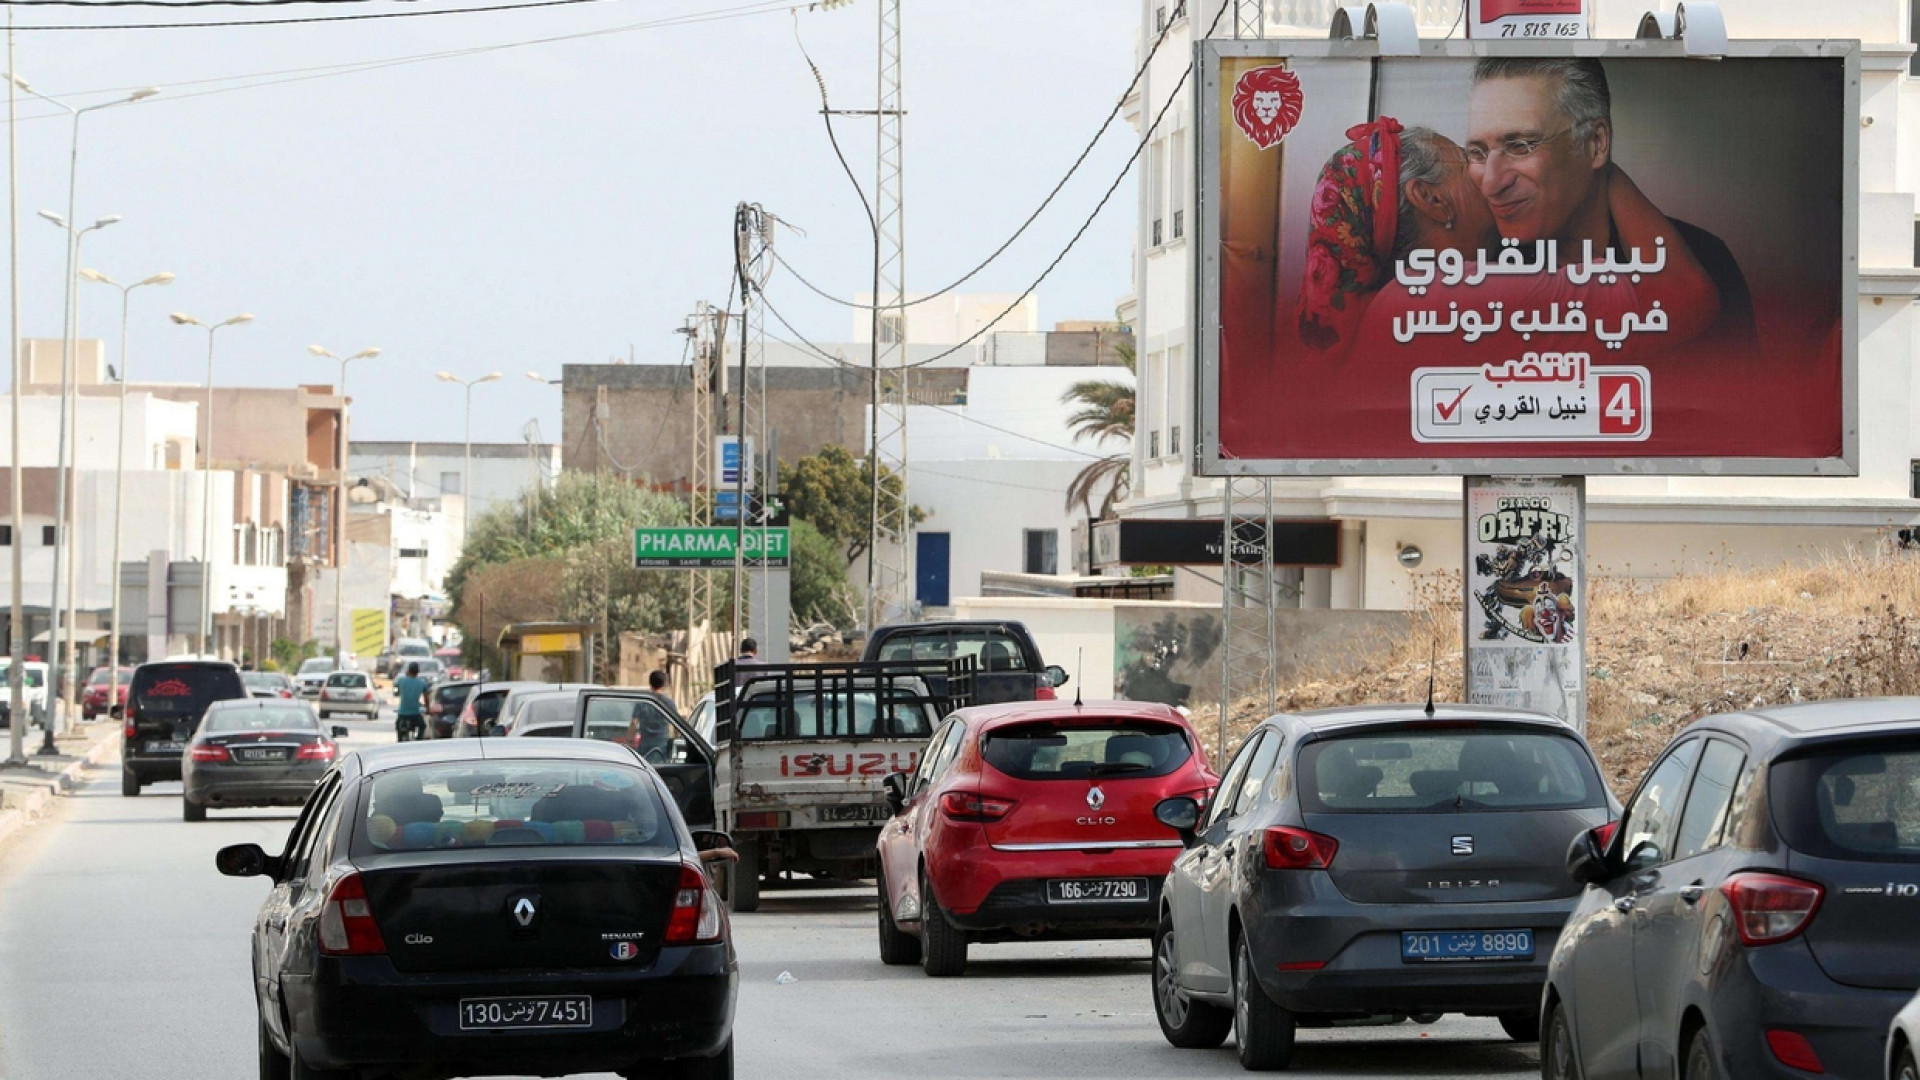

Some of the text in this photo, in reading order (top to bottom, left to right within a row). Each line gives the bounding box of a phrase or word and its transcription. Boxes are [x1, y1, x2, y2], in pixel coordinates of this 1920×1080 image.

[1501, 22, 1580, 37] 71 818 163
[1395, 236, 1667, 295] نبيل القروي
[1392, 300, 1669, 349] في قلب تونس
[1474, 395, 1587, 425] نبيل القروي
[1604, 383, 1636, 426] 4
[1498, 497, 1551, 510] CIRCO
[1479, 510, 1569, 542] ORFEI
[780, 751, 918, 777] ISUZU
[1076, 816, 1116, 825] CLIO
[1059, 881, 1137, 898] 166 تونس 7290
[601, 932, 645, 940] RENAULT
[1407, 933, 1529, 954] 201 تونس 8890
[465, 1000, 587, 1024] 130 تونس 7451
